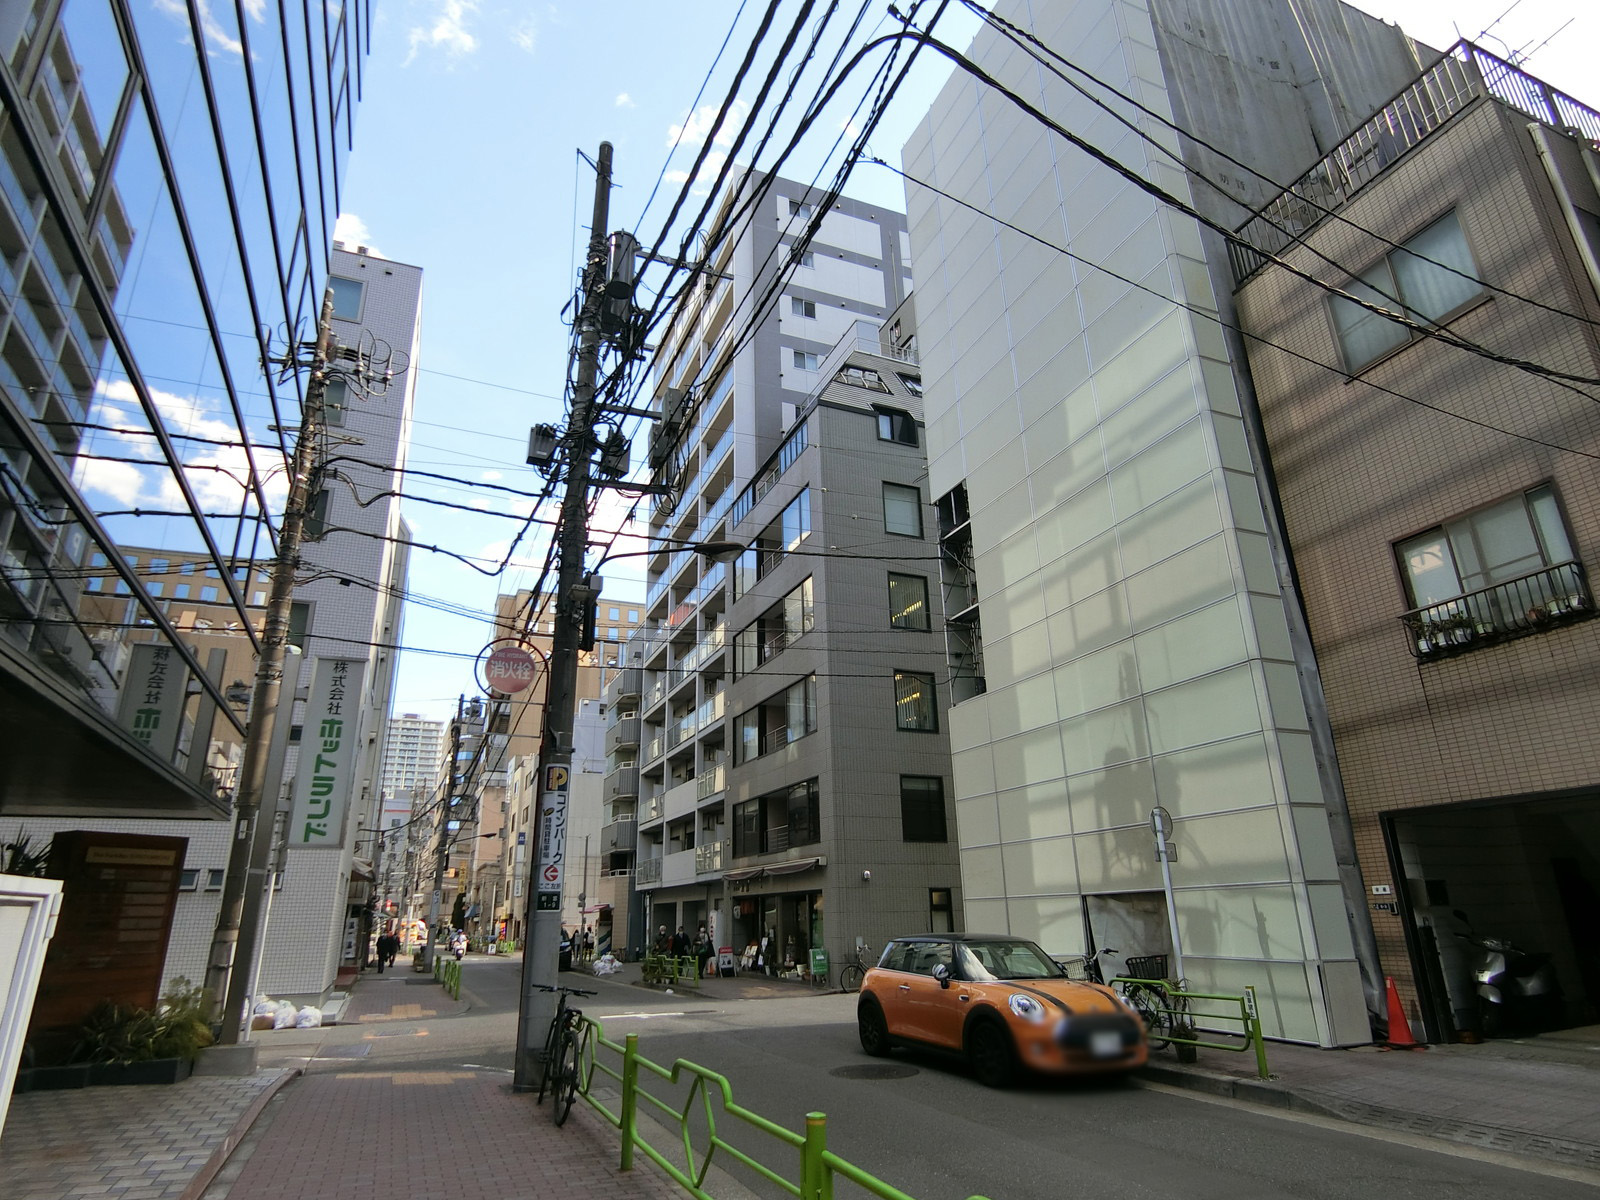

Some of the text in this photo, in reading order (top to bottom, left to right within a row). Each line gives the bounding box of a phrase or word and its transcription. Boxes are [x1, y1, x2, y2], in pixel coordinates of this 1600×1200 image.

[489, 660, 532, 680] 消火栓
[303, 660, 349, 842] 株式会社 ホットランド
